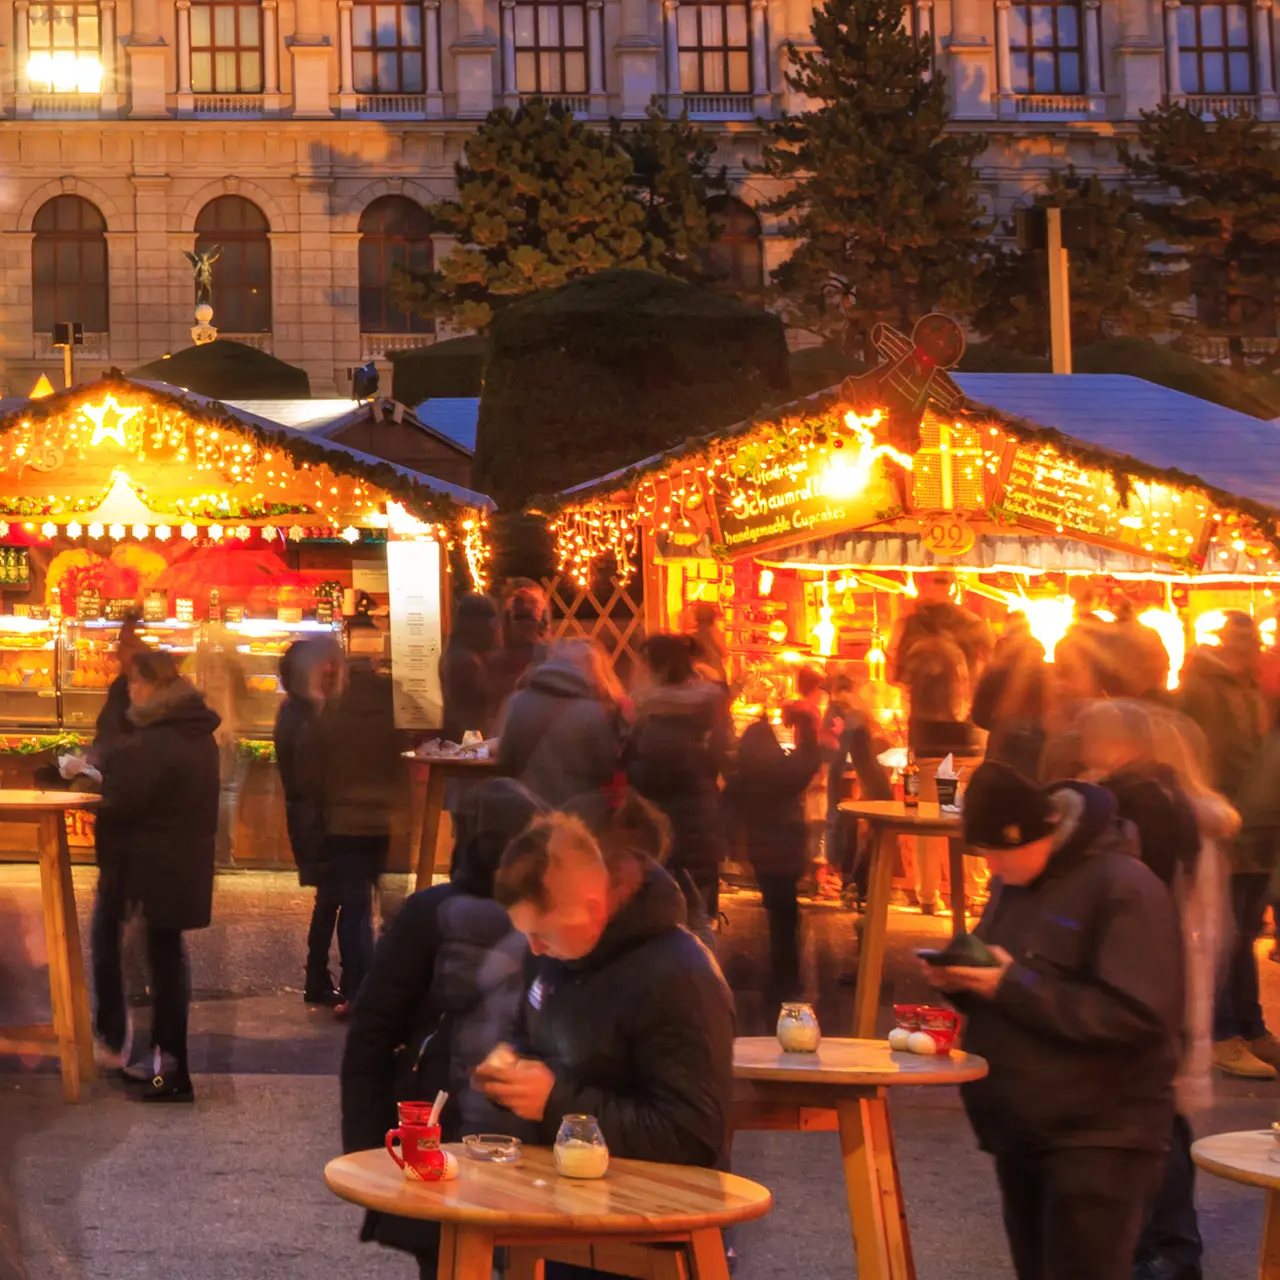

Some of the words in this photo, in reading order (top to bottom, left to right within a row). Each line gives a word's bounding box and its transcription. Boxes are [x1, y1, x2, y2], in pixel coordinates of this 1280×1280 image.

[38, 449, 58, 468] 15
[791, 504, 846, 530] Cupcakes
[930, 524, 965, 549] 22
